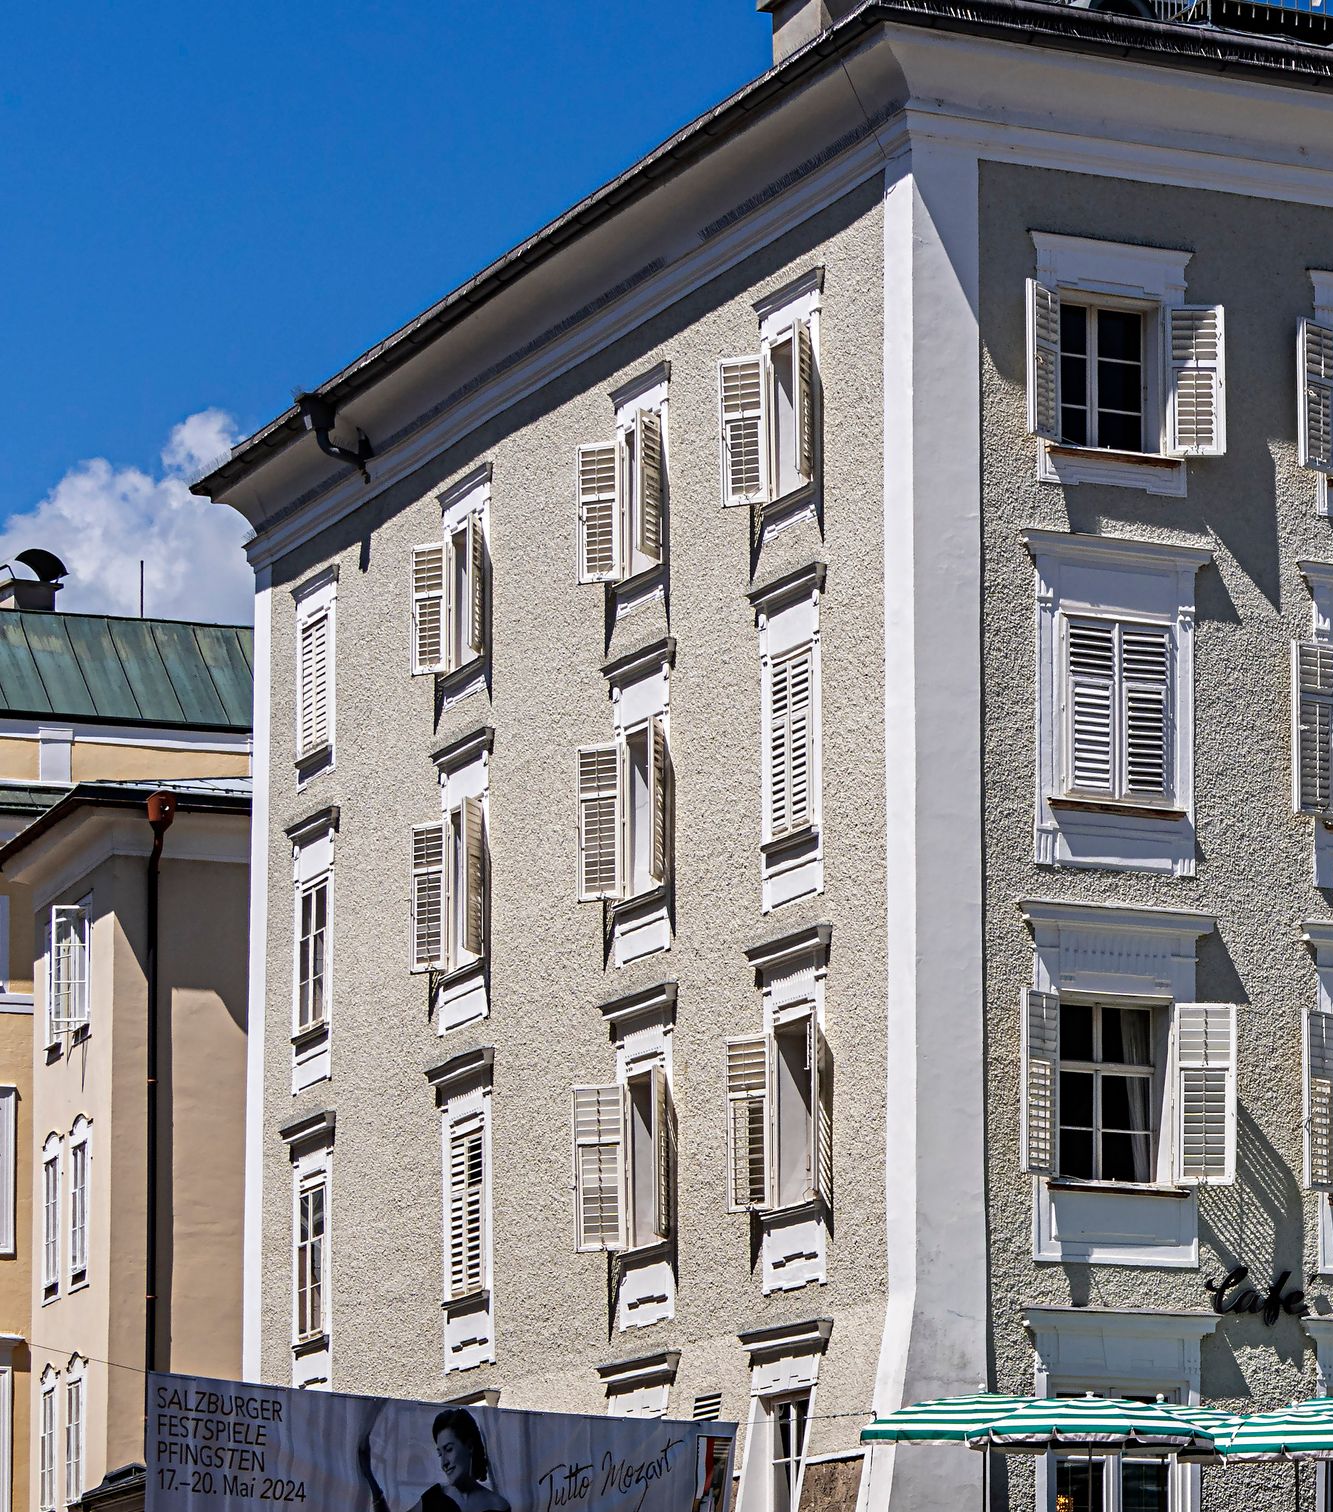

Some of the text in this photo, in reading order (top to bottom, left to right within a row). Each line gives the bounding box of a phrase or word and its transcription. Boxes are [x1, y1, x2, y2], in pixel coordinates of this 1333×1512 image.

[1205, 1266, 1317, 1327] Café
[157, 1387, 283, 1422] SALZBURGER
[157, 1414, 267, 1446] FESTSPIELE
[157, 1440, 266, 1472] PFINGSTEN
[223, 1474, 256, 1498] Mai
[260, 1477, 306, 1502] 2024
